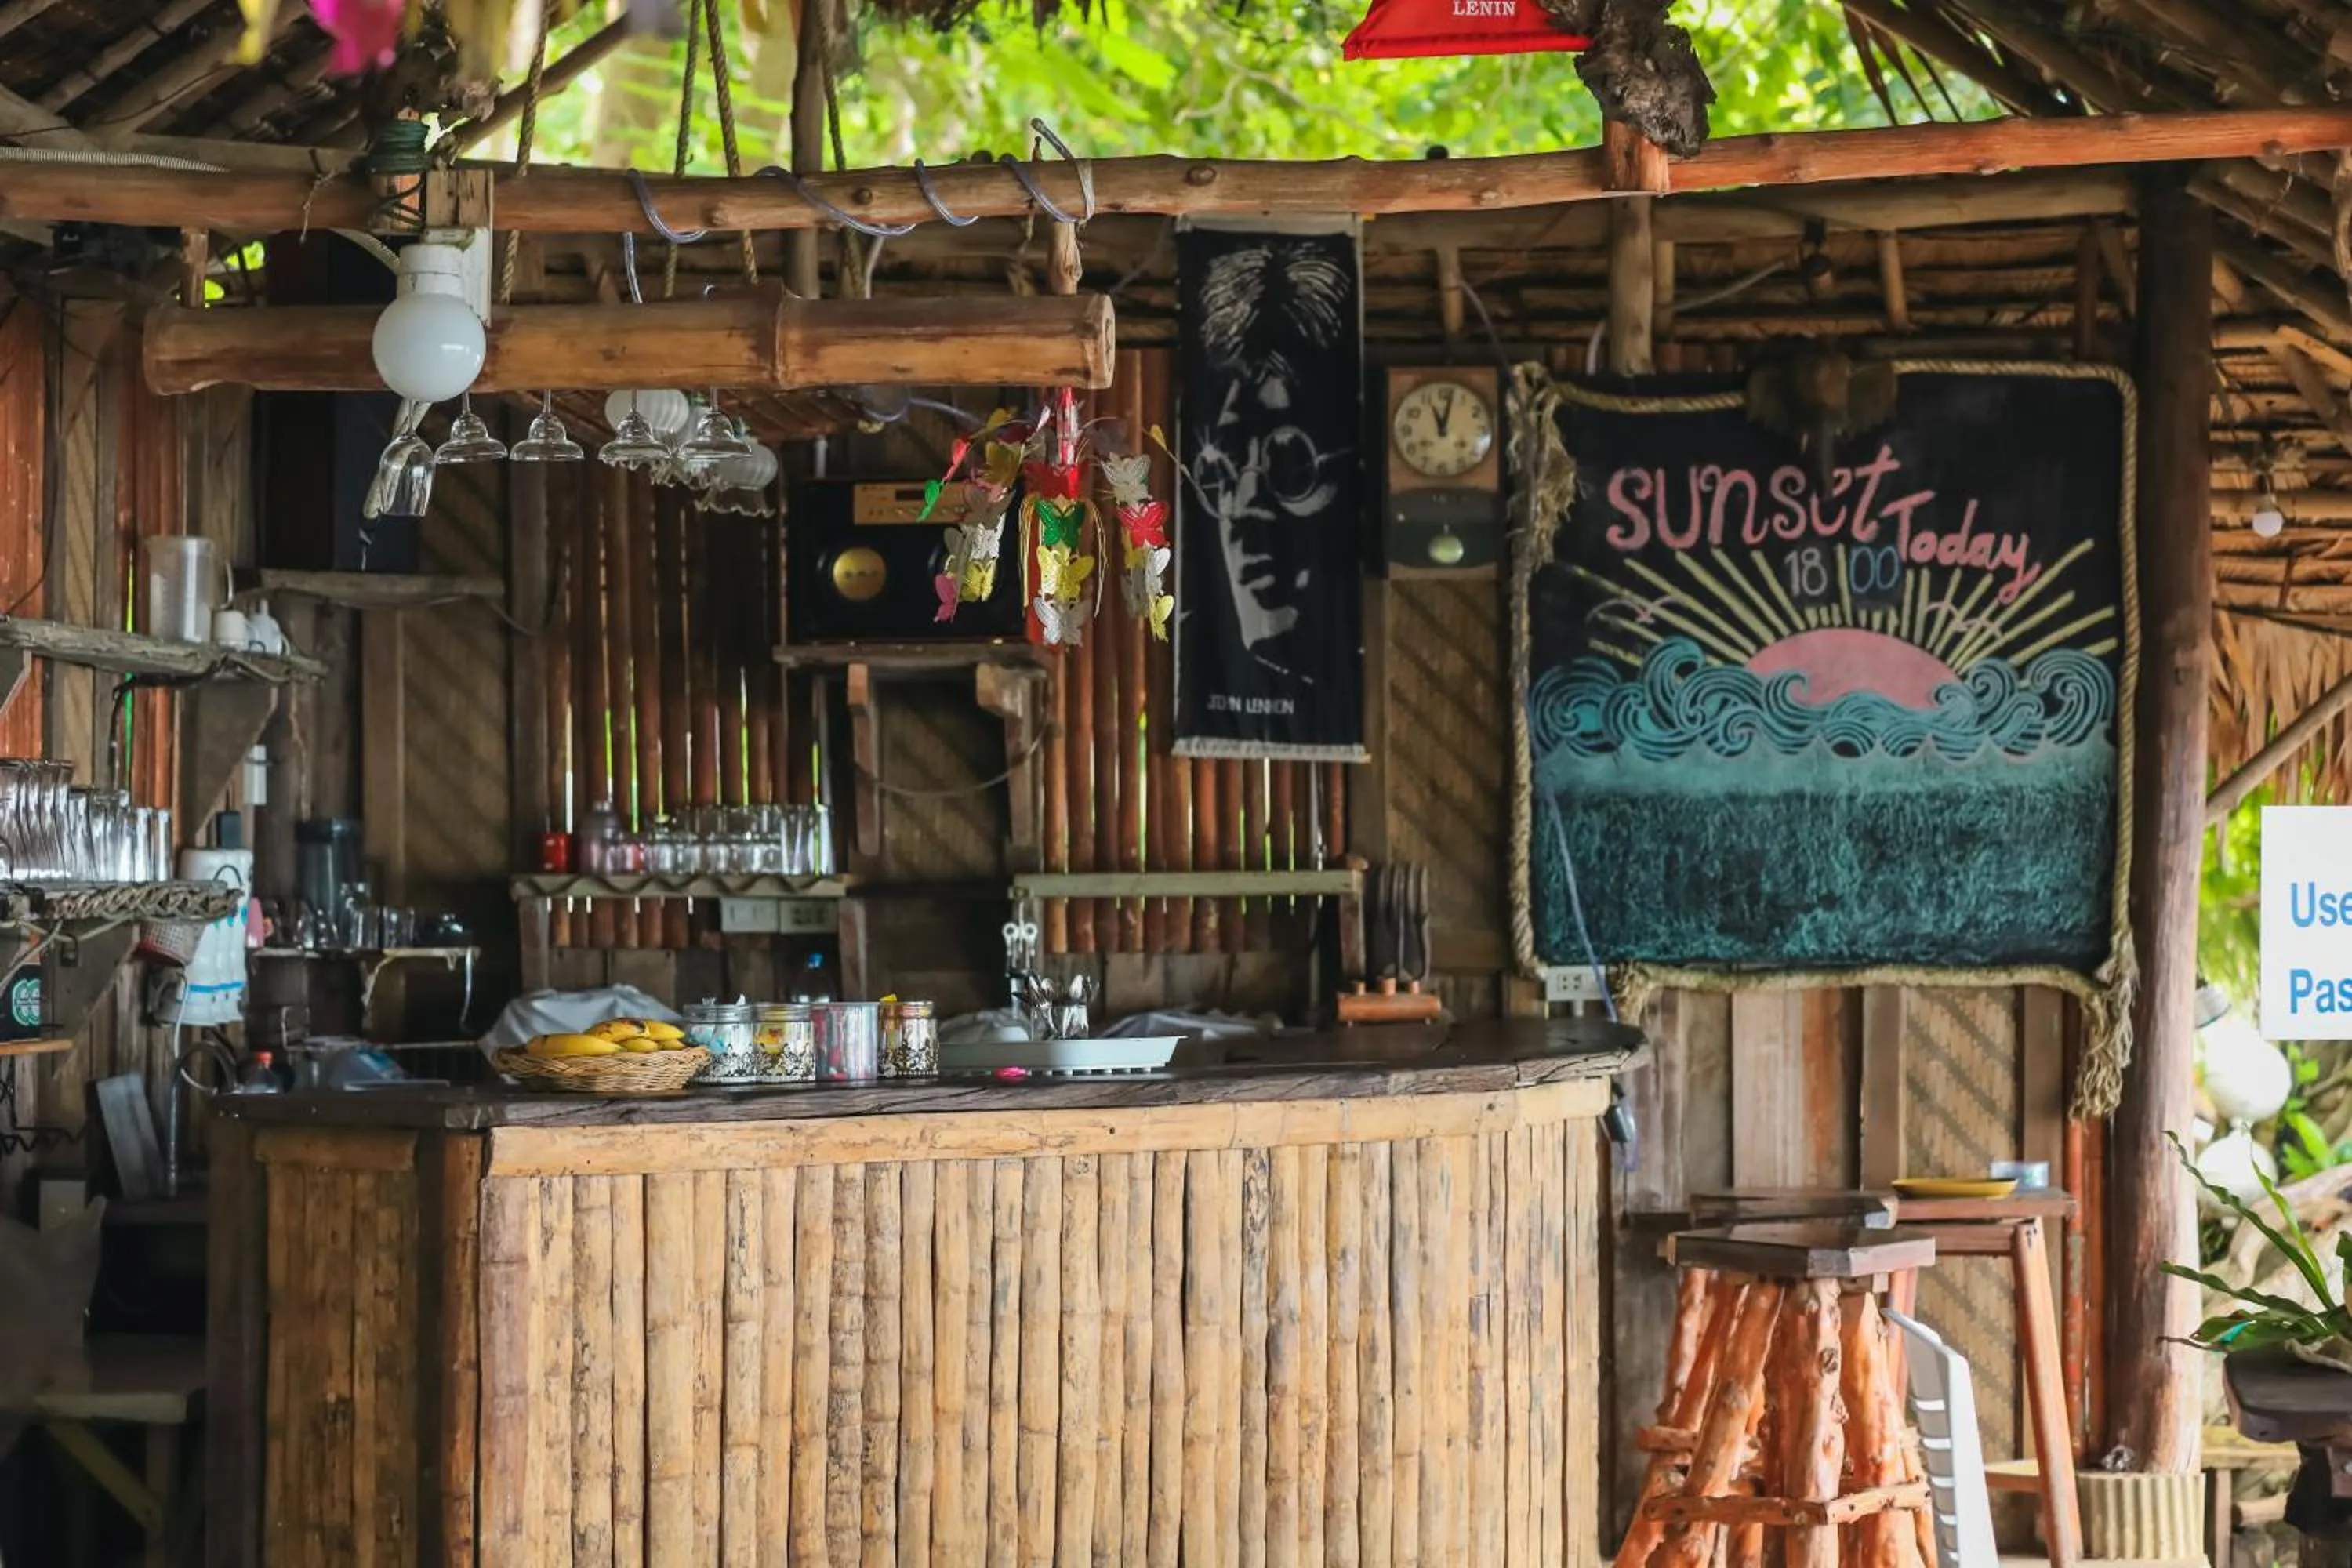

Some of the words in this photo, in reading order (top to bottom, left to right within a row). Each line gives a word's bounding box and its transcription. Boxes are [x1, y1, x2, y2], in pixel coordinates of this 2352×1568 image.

[1452, 0, 1516, 16] LENIN
[1879, 489, 2042, 605] Today
[1784, 547, 1828, 597] 18
[1849, 546, 1900, 594] 00
[2289, 969, 2352, 1014] Pas
